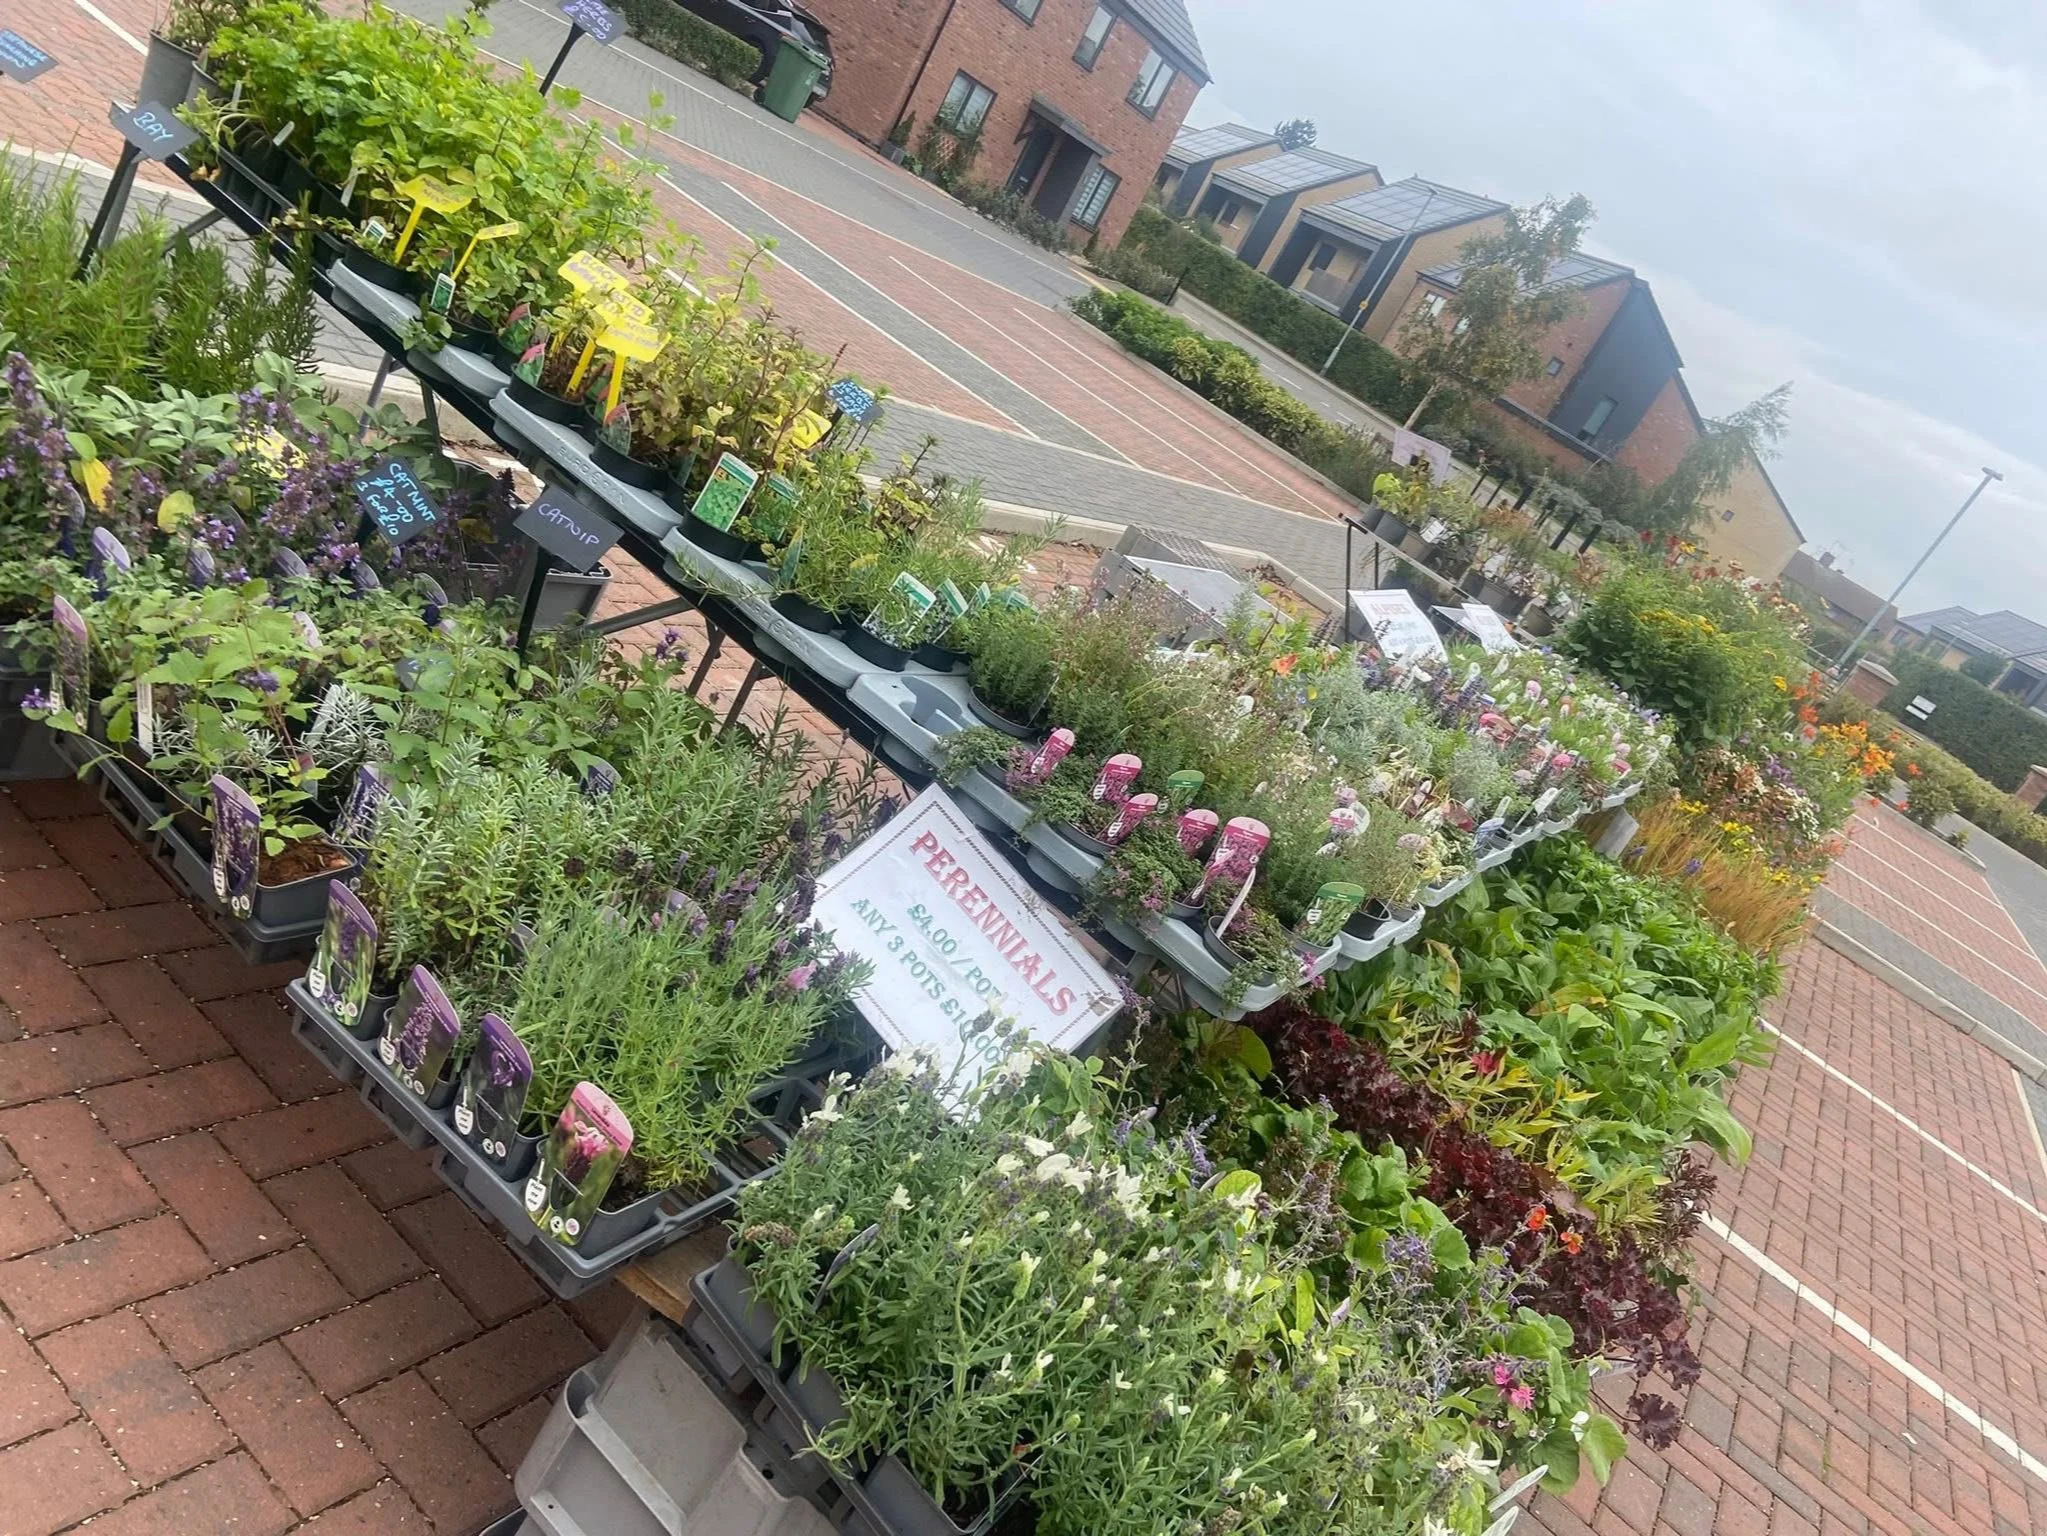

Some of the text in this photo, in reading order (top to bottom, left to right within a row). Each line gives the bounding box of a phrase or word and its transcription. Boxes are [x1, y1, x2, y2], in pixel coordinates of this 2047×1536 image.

[133, 112, 174, 142] BAY
[356, 481, 369, 492] 3
[538, 503, 600, 545] CATNIP
[908, 830, 1078, 1017] PERENNIALS
[851, 899, 898, 936] ANY
[887, 936, 904, 953] 3
[900, 950, 947, 1000] POTS
